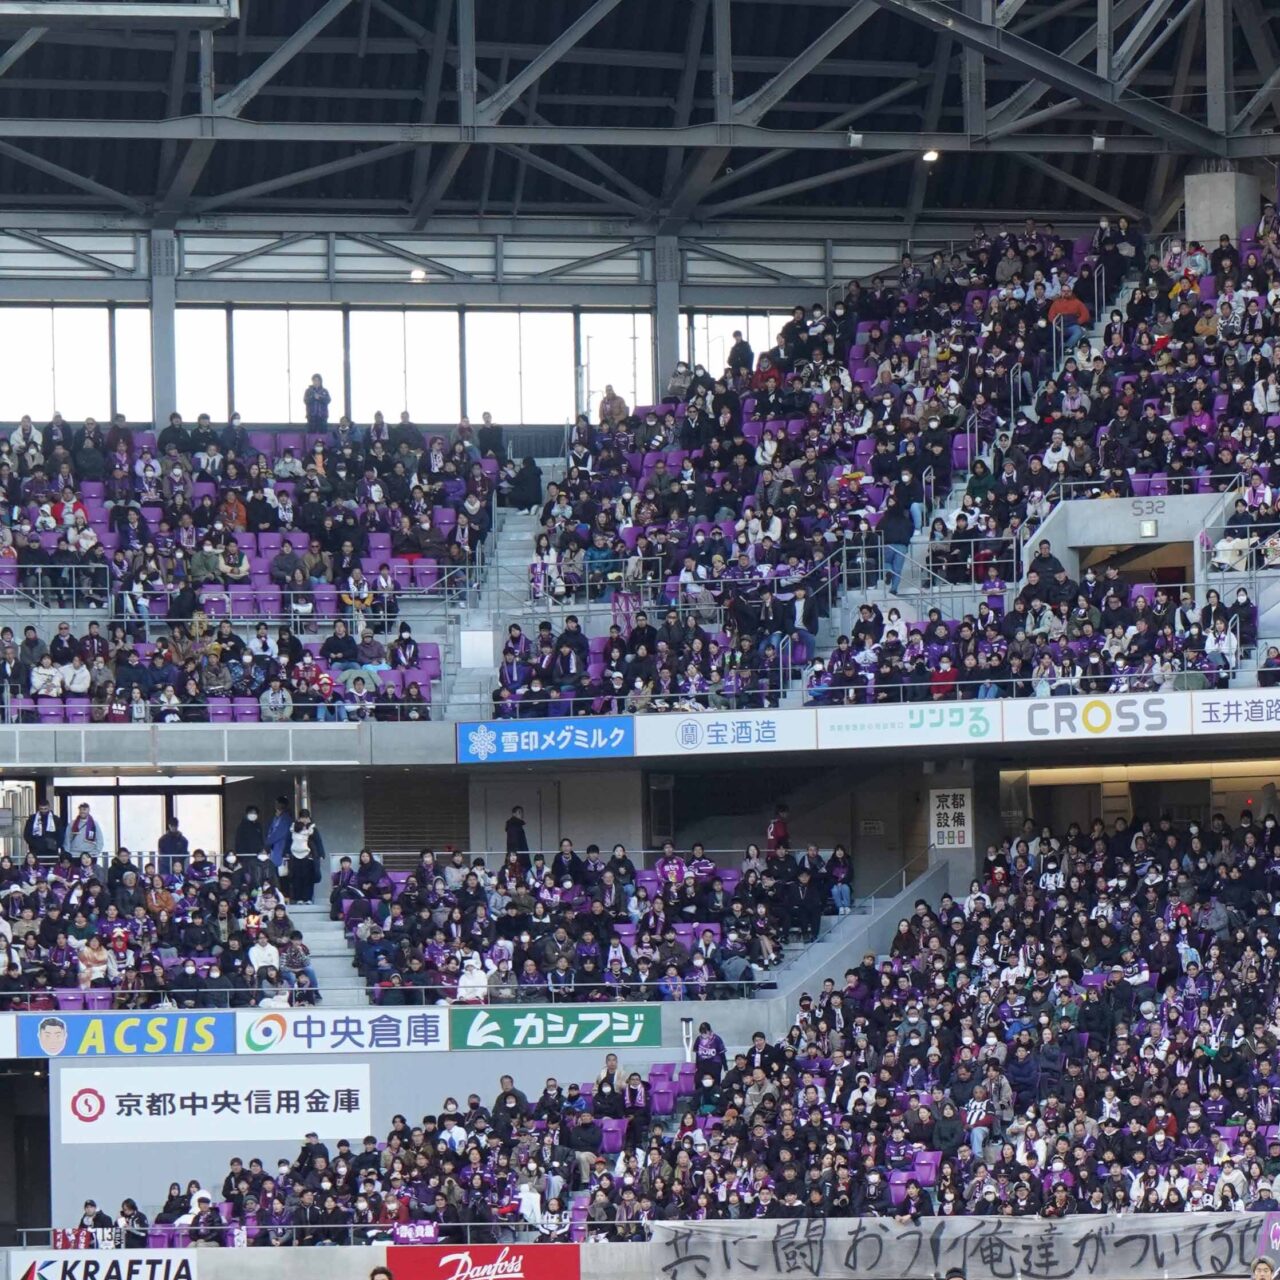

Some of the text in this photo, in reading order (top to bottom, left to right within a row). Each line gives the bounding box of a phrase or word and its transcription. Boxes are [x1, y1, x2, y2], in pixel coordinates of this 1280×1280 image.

[1131, 499, 1166, 517] S32
[1027, 698, 1168, 737] CROSS
[501, 726, 626, 754] 雪印メグミルク
[706, 719, 778, 747] 宝酒造
[935, 793, 966, 810] 京都
[935, 811, 966, 829] 設備
[77, 1015, 218, 1055] ACSIS
[291, 1013, 441, 1049] 中央倉庫
[512, 1012, 644, 1046] カシフジ
[114, 1088, 361, 1118] 京都中央信用金庫
